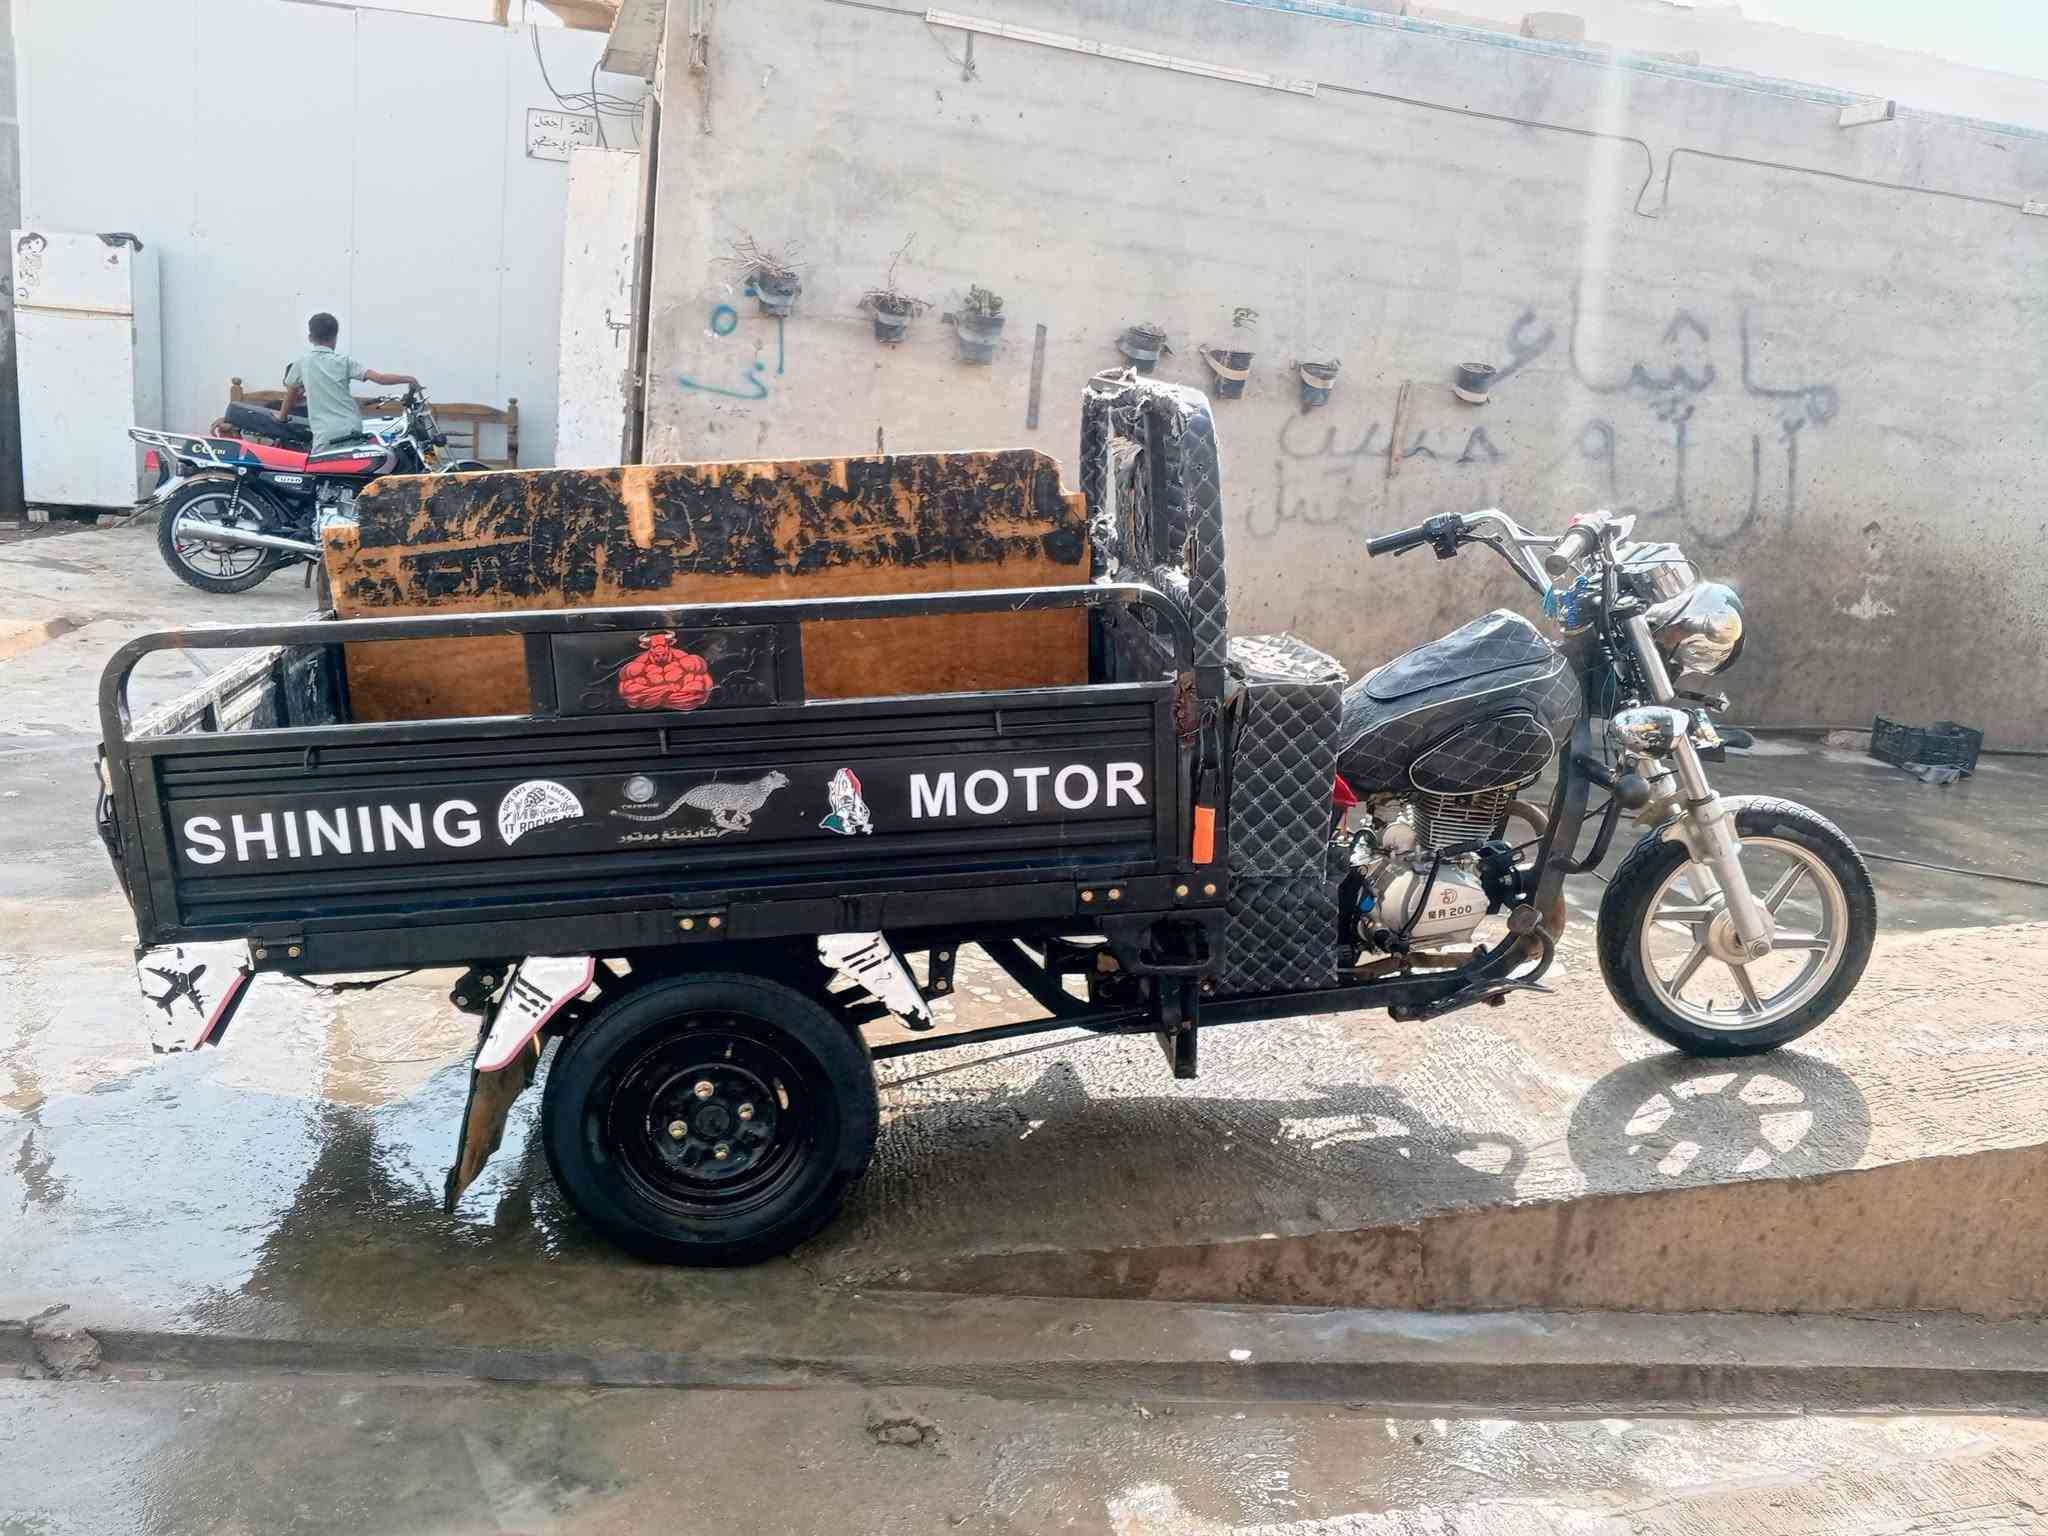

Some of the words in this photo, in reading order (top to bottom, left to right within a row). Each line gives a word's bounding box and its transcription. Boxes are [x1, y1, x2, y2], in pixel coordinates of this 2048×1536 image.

[909, 762, 1147, 818] MOTOR
[183, 799, 482, 864] SHINING
[505, 824, 515, 834] IT
[1449, 904, 1472, 917] 200
